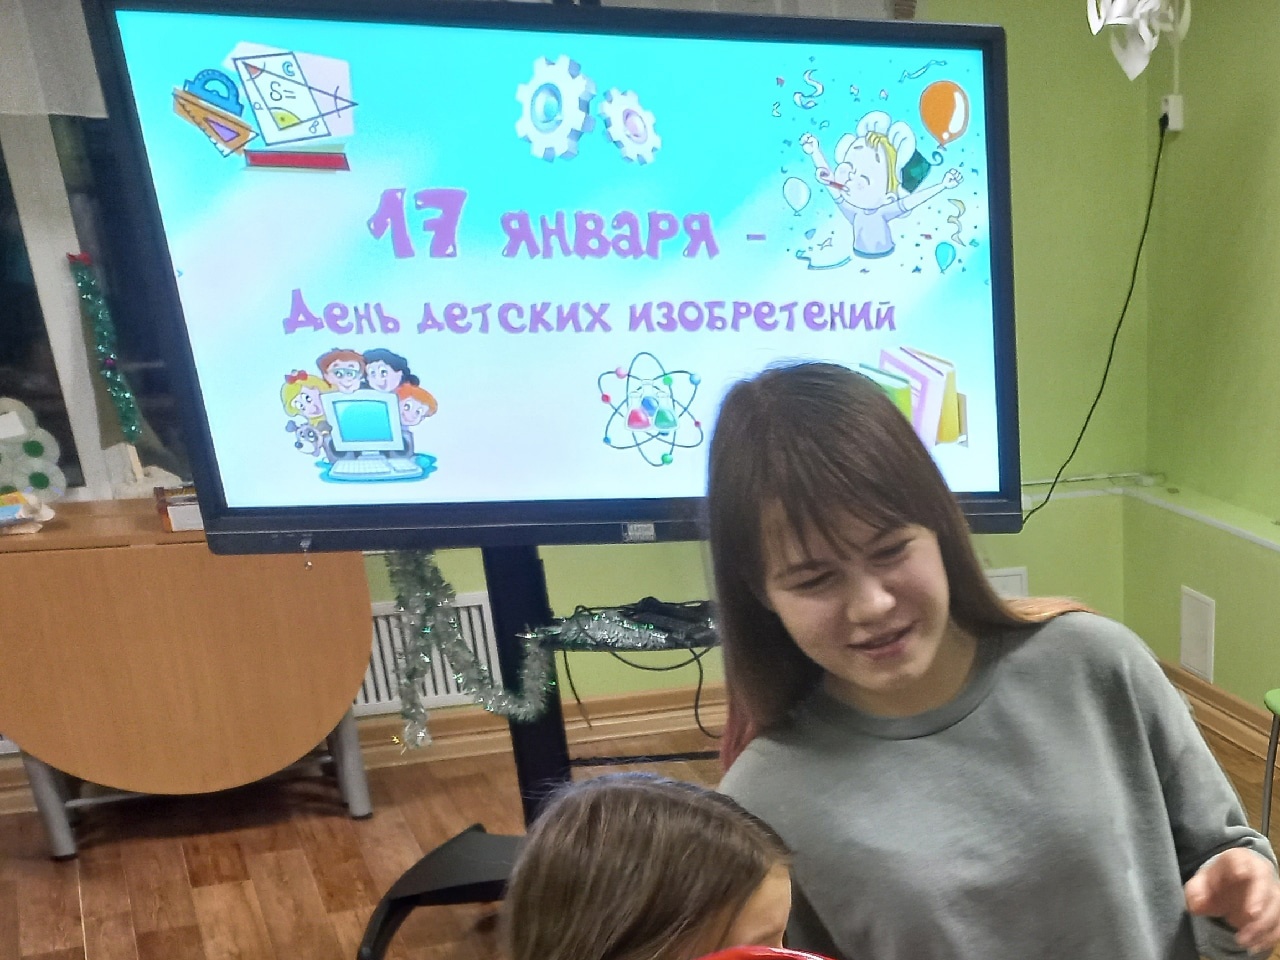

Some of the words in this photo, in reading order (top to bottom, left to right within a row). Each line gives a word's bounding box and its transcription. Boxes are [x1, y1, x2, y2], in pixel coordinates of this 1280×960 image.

[367, 187, 467, 259] 17
[500, 210, 719, 259] января
[282, 288, 400, 335] День
[416, 301, 612, 334] детских
[628, 300, 896, 333] изобретений
